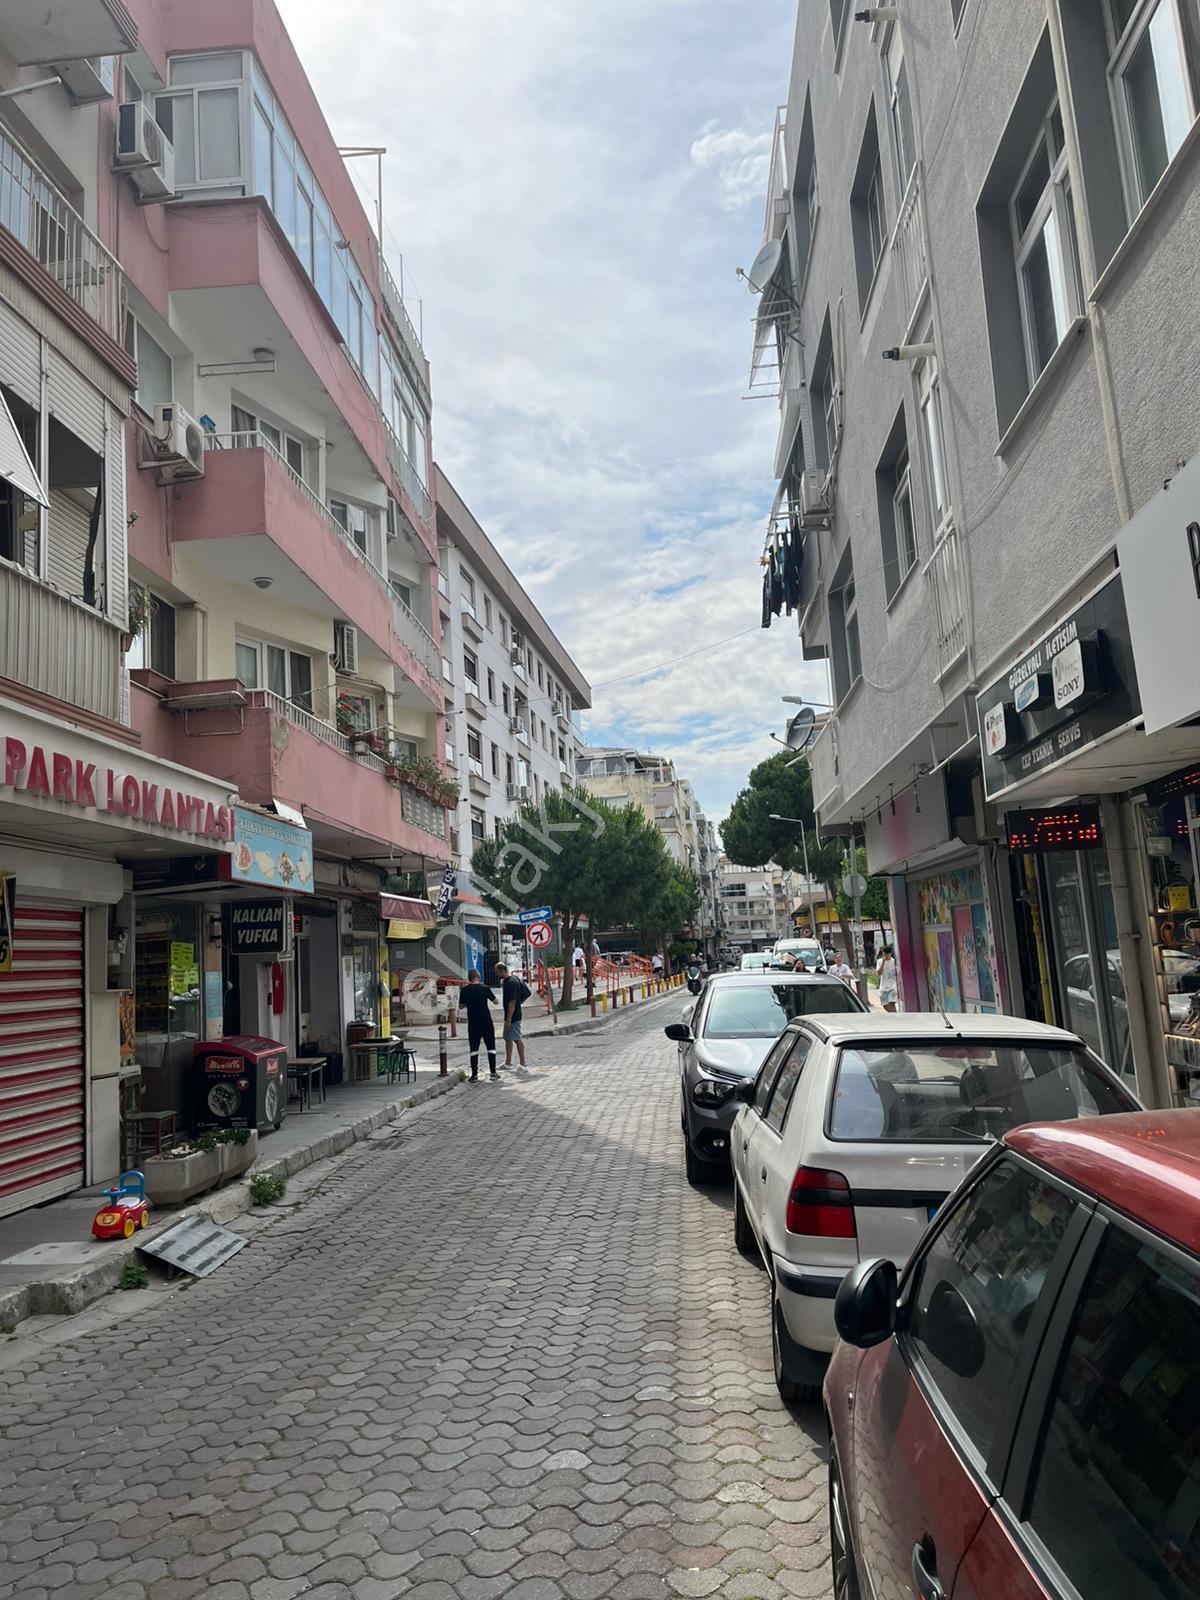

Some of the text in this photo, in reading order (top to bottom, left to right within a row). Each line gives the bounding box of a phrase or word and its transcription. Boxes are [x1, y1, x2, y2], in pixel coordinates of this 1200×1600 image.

[1057, 675, 1080, 701] SONY
[1057, 721, 1082, 749] SERVİS
[5, 736, 97, 808] PARK
[104, 768, 235, 842] LOKANTASI
[232, 907, 283, 924] KALKAN
[237, 928, 279, 945] YUFKA
